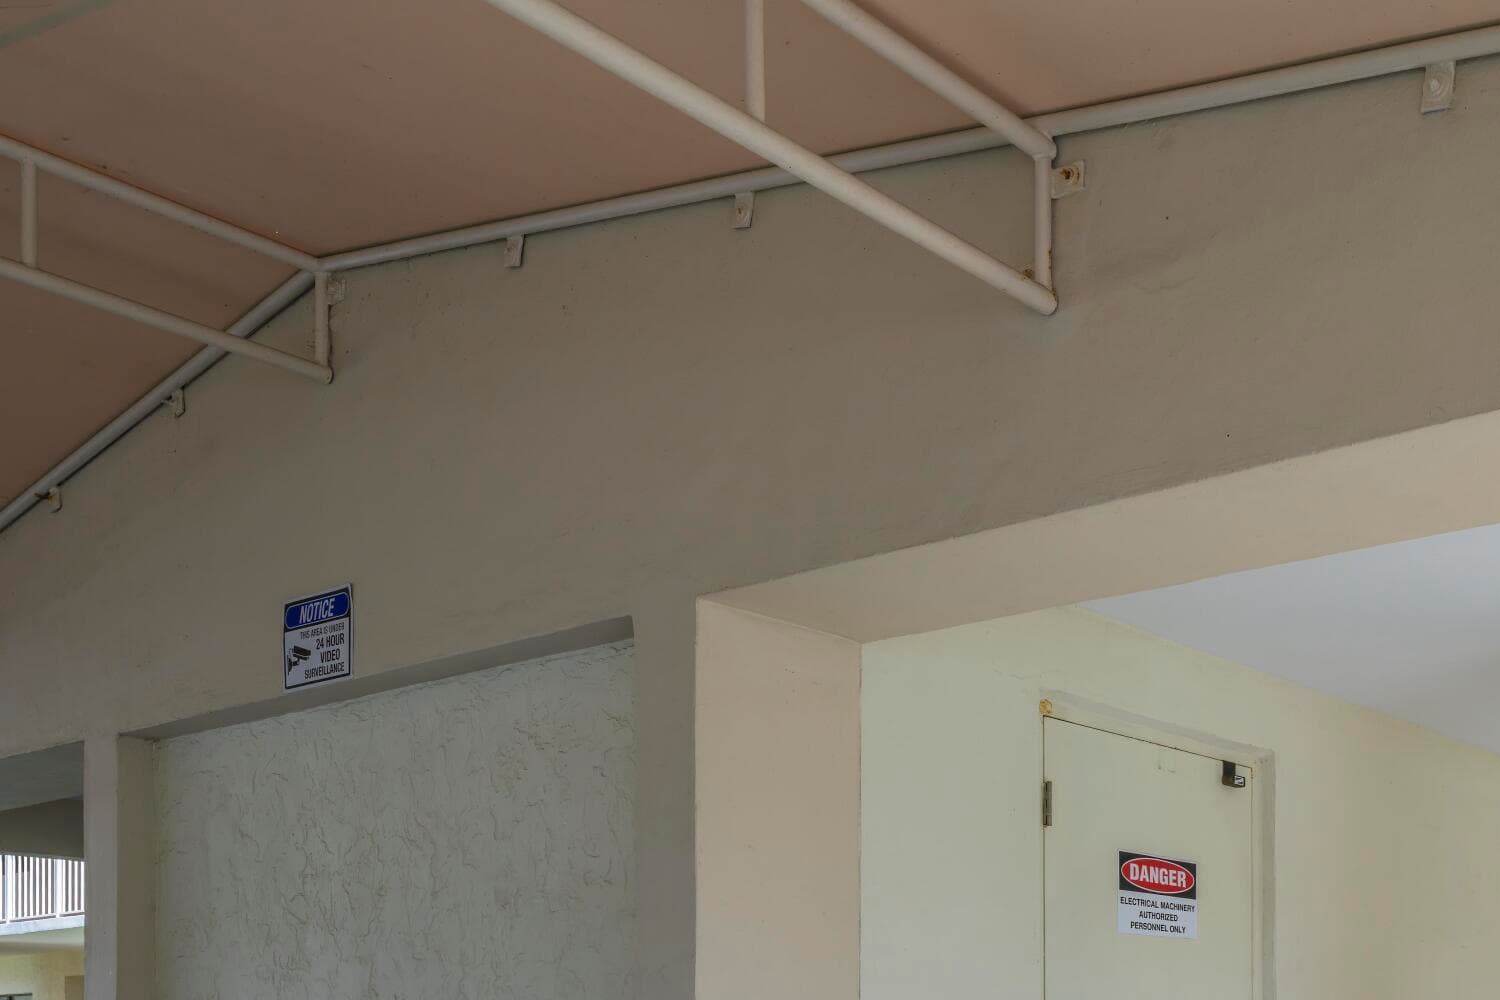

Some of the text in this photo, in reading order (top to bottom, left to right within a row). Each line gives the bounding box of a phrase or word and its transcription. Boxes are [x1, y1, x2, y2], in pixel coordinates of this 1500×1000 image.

[299, 598, 335, 624] NOTICE
[300, 631, 310, 640] THIS
[324, 626, 329, 634] IS
[316, 633, 345, 650] 24 HOUR
[320, 648, 341, 663] VIDEO
[304, 662, 345, 679] SURVEILLANCE
[1129, 863, 1187, 888] DANGER
[1120, 897, 1195, 912] ELECTRICAL MACHINERY
[1139, 910, 1179, 922] AUTHORIZED
[1130, 921, 1186, 934] PERSONNEL ONLY
